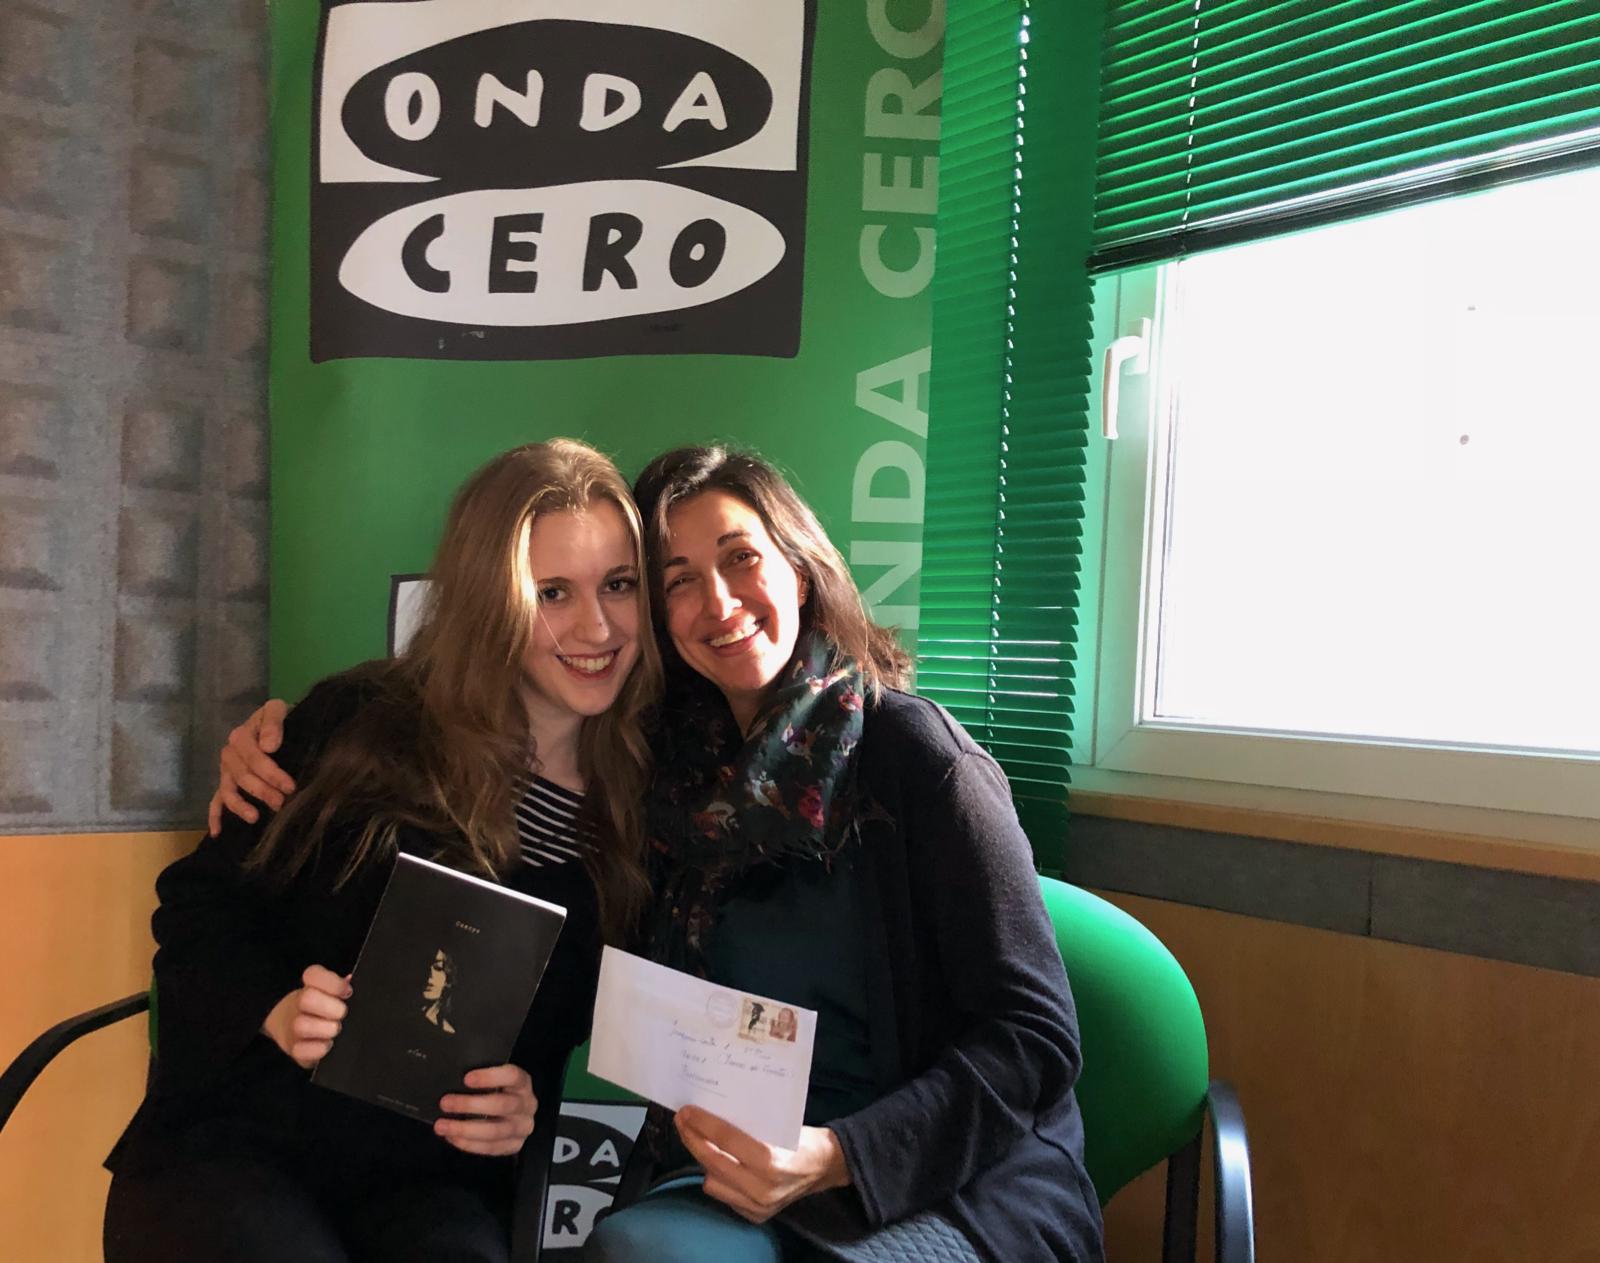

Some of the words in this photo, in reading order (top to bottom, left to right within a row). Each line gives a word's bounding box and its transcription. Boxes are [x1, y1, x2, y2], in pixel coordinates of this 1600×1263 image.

[384, 69, 728, 141] ONDA
[401, 212, 727, 294] CERO
[850, 345, 932, 630] NDA
[552, 1136, 620, 1168] DA
